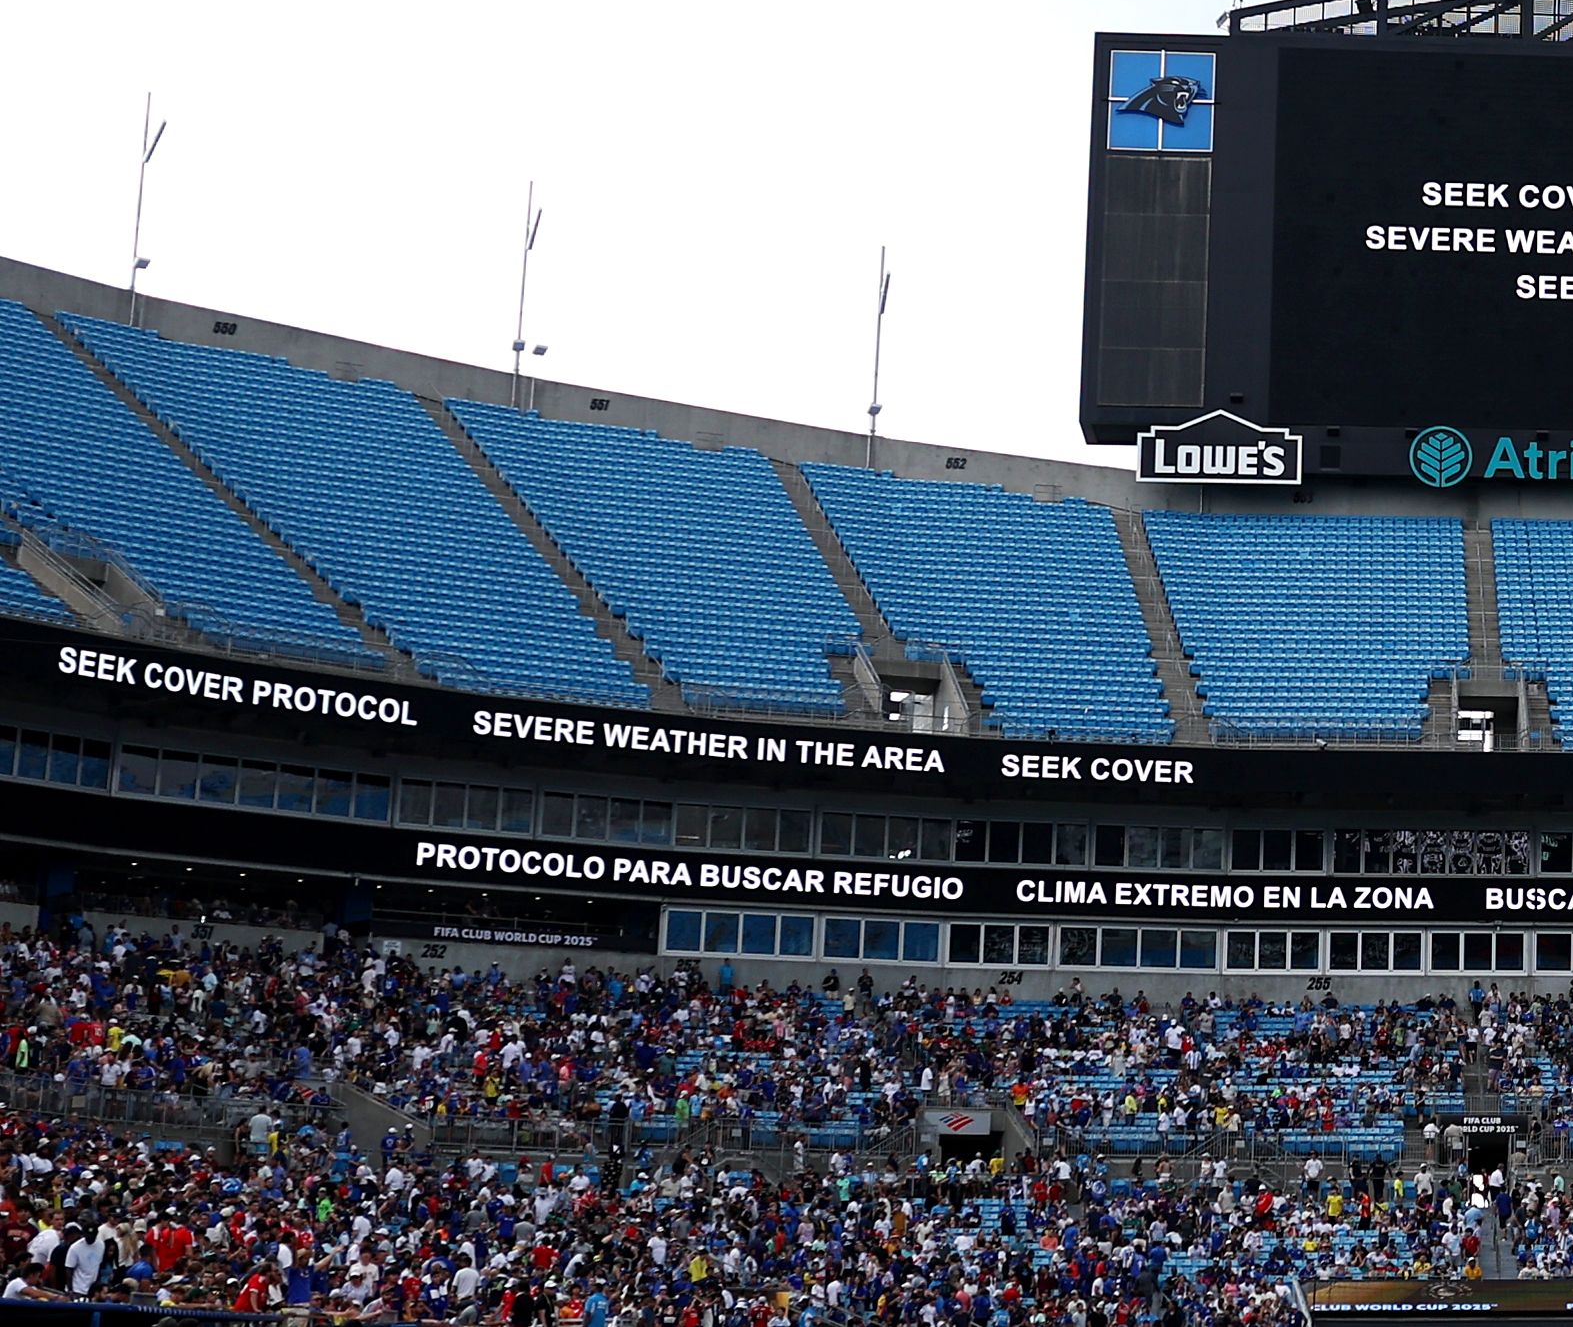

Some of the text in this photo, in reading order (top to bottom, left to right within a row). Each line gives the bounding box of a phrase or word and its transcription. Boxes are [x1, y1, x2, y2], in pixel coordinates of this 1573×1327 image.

[1421, 181, 1509, 208] SEEK
[1365, 225, 1496, 253] SEVERE
[213, 321, 237, 335] 550
[589, 398, 610, 412] 551
[946, 458, 967, 470] 552
[1154, 438, 1285, 477] LOWE'S
[58, 646, 418, 726] SEEK COVER PROTOCOL
[472, 710, 945, 773] SEVERE WEATHER IN THE AREA
[1001, 754, 1194, 784] SEEK COVER
[416, 842, 964, 900] PROTOCOLO PARA BUSCAR REFUGIO
[1016, 879, 1435, 910] CLIMA EXTREMO EN LA ZONA
[434, 927, 459, 938] FIFA
[461, 928, 492, 940] CLUB
[494, 931, 536, 943] WORLD
[538, 934, 562, 945] CUP
[421, 944, 447, 959] 252
[999, 971, 1024, 985] 254
[1306, 977, 1331, 991] 255
[1463, 1117, 1502, 1125] FIFA CLUB
[1479, 1125, 1495, 1133] CUP
[1311, 1303, 1352, 1311] CLUB
[1355, 1303, 1413, 1311] WORLD
[1417, 1303, 1449, 1311] CUP
